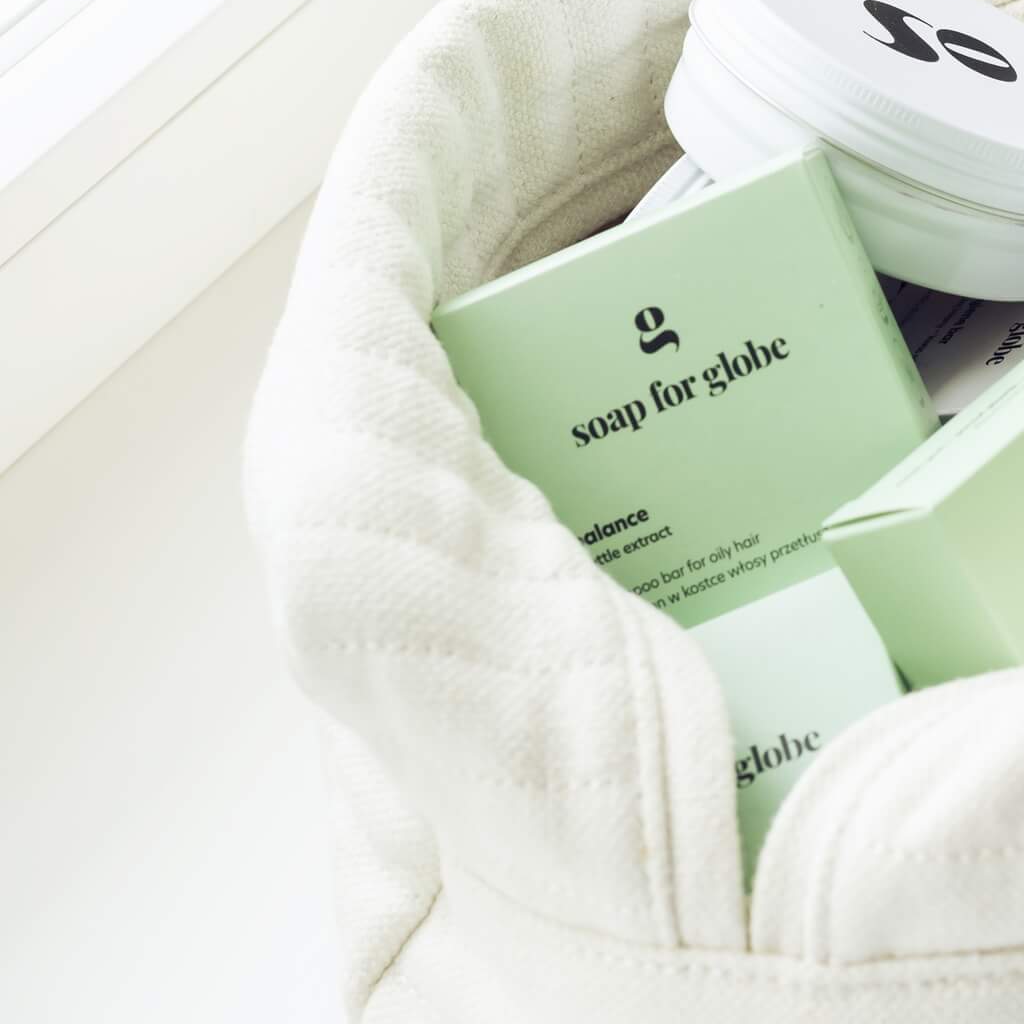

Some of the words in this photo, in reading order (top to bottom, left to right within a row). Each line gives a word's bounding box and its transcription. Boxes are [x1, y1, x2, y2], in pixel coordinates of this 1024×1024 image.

[634, 306, 680, 355] g
[571, 399, 647, 448] soap
[649, 376, 697, 413] for
[702, 337, 790, 397] globe
[593, 548, 622, 566] ttle
[623, 525, 673, 554] extract
[660, 566, 685, 584] bar
[686, 557, 706, 573] for
[709, 546, 732, 564] oily
[732, 533, 760, 553] hair
[667, 592, 681, 605] w
[681, 572, 726, 598] kostce
[727, 554, 768, 578] włosy
[735, 730, 822, 790] globe
